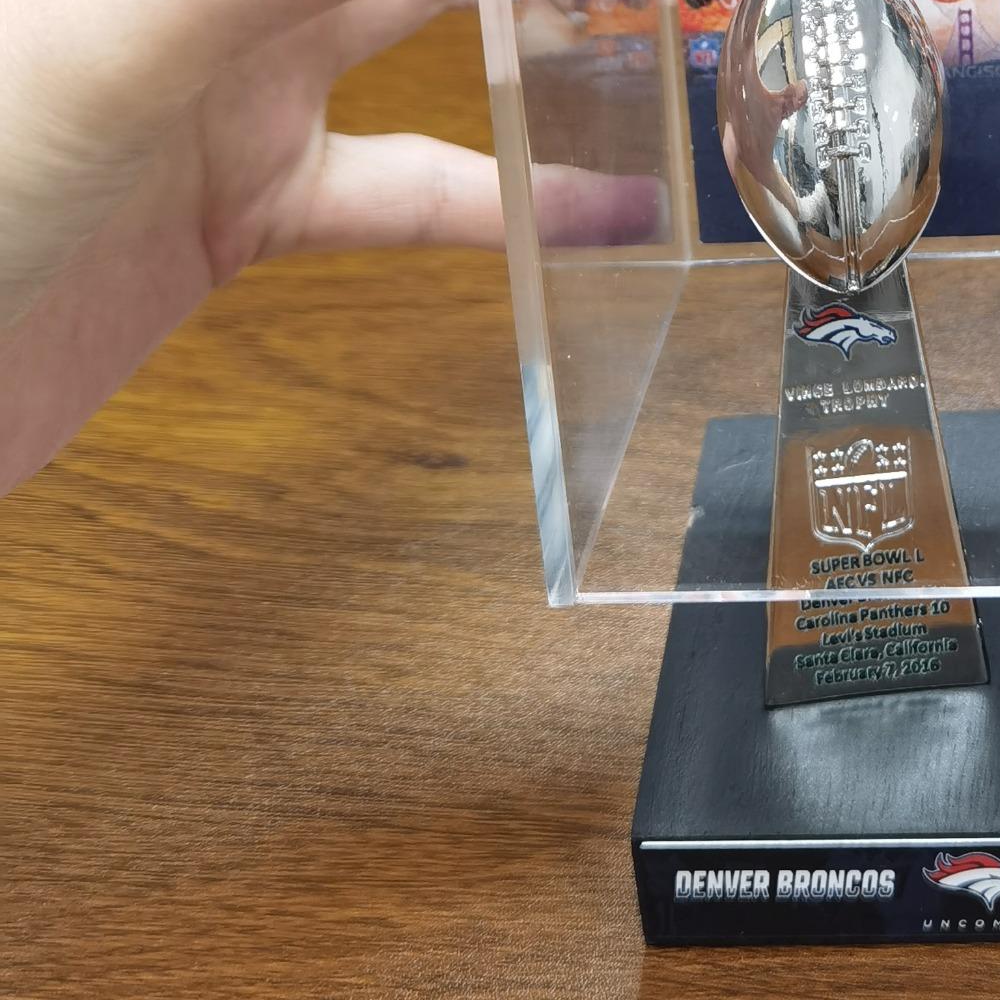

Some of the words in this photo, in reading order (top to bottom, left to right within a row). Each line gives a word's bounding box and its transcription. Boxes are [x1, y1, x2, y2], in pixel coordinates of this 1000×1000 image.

[810, 554, 860, 576] SUPER
[861, 549, 911, 568] BOWL
[857, 570, 877, 587] VS
[882, 568, 914, 585] NFC
[795, 608, 858, 630] Carolina
[859, 602, 927, 622] Panthers
[931, 600, 950, 615] 10
[864, 622, 928, 641] Stadium
[794, 652, 839, 670] Santa
[885, 637, 958, 657] California
[815, 663, 882, 686] February
[900, 657, 942, 675] 2016
[675, 870, 770, 898] DENVER
[776, 869, 896, 897] BRONCOS
